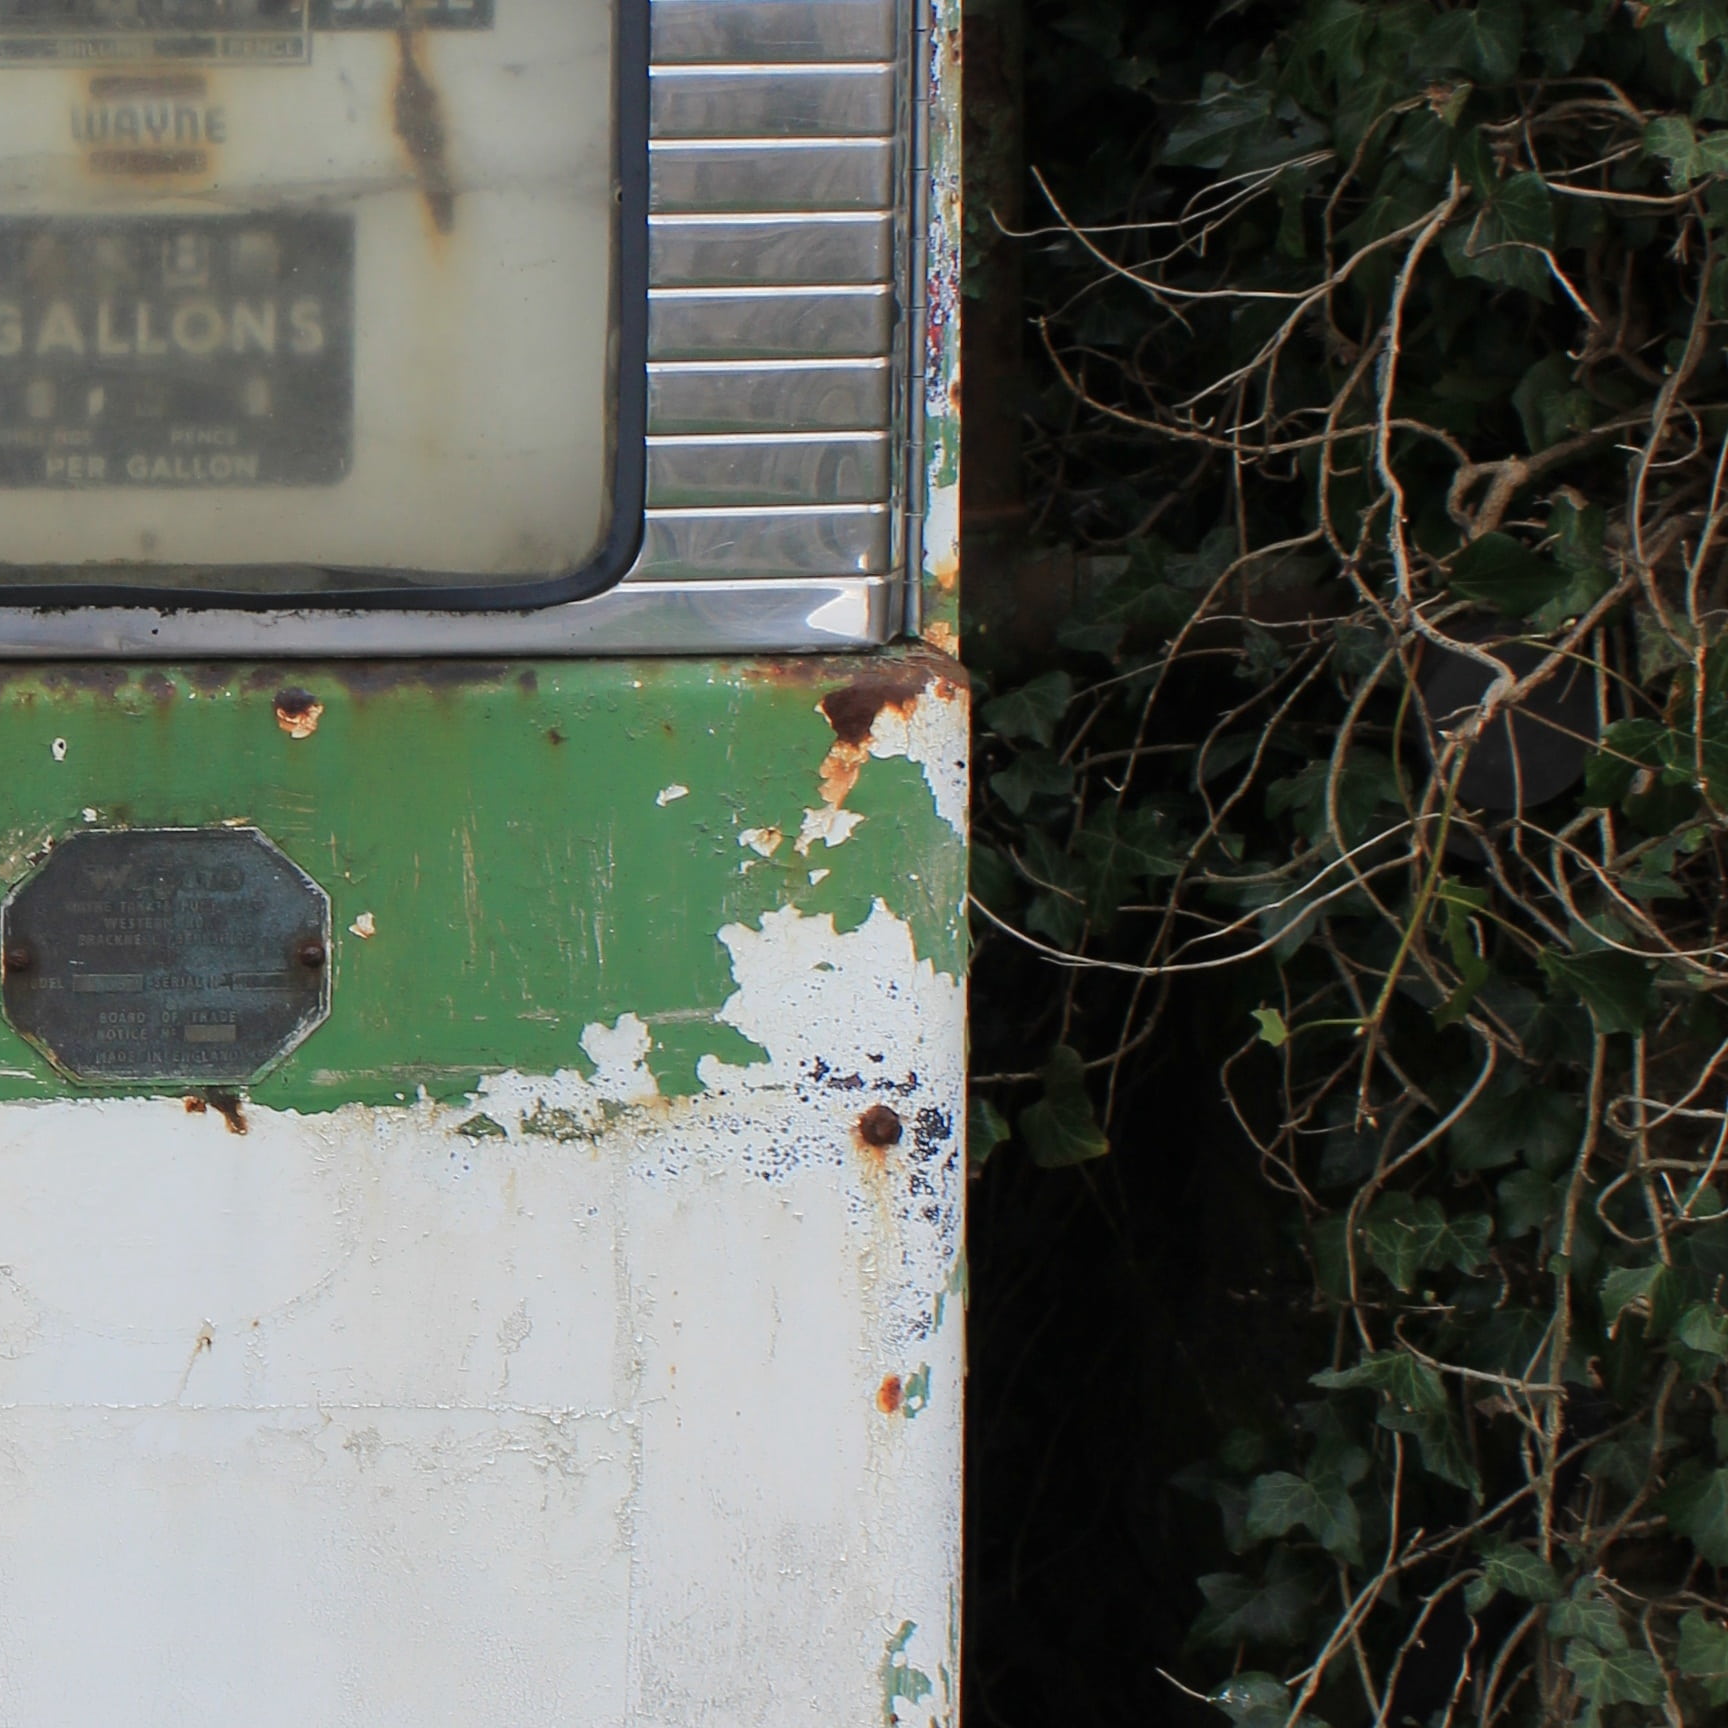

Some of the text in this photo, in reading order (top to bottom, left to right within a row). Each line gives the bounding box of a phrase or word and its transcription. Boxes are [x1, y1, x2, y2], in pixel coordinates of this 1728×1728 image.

[72, 104, 228, 144] WAYNE
[45, 454, 260, 479] PER GALLON
[98, 1010, 146, 1023] BOARD
[161, 1010, 178, 1023] OF
[96, 1028, 148, 1041] NOTICE
